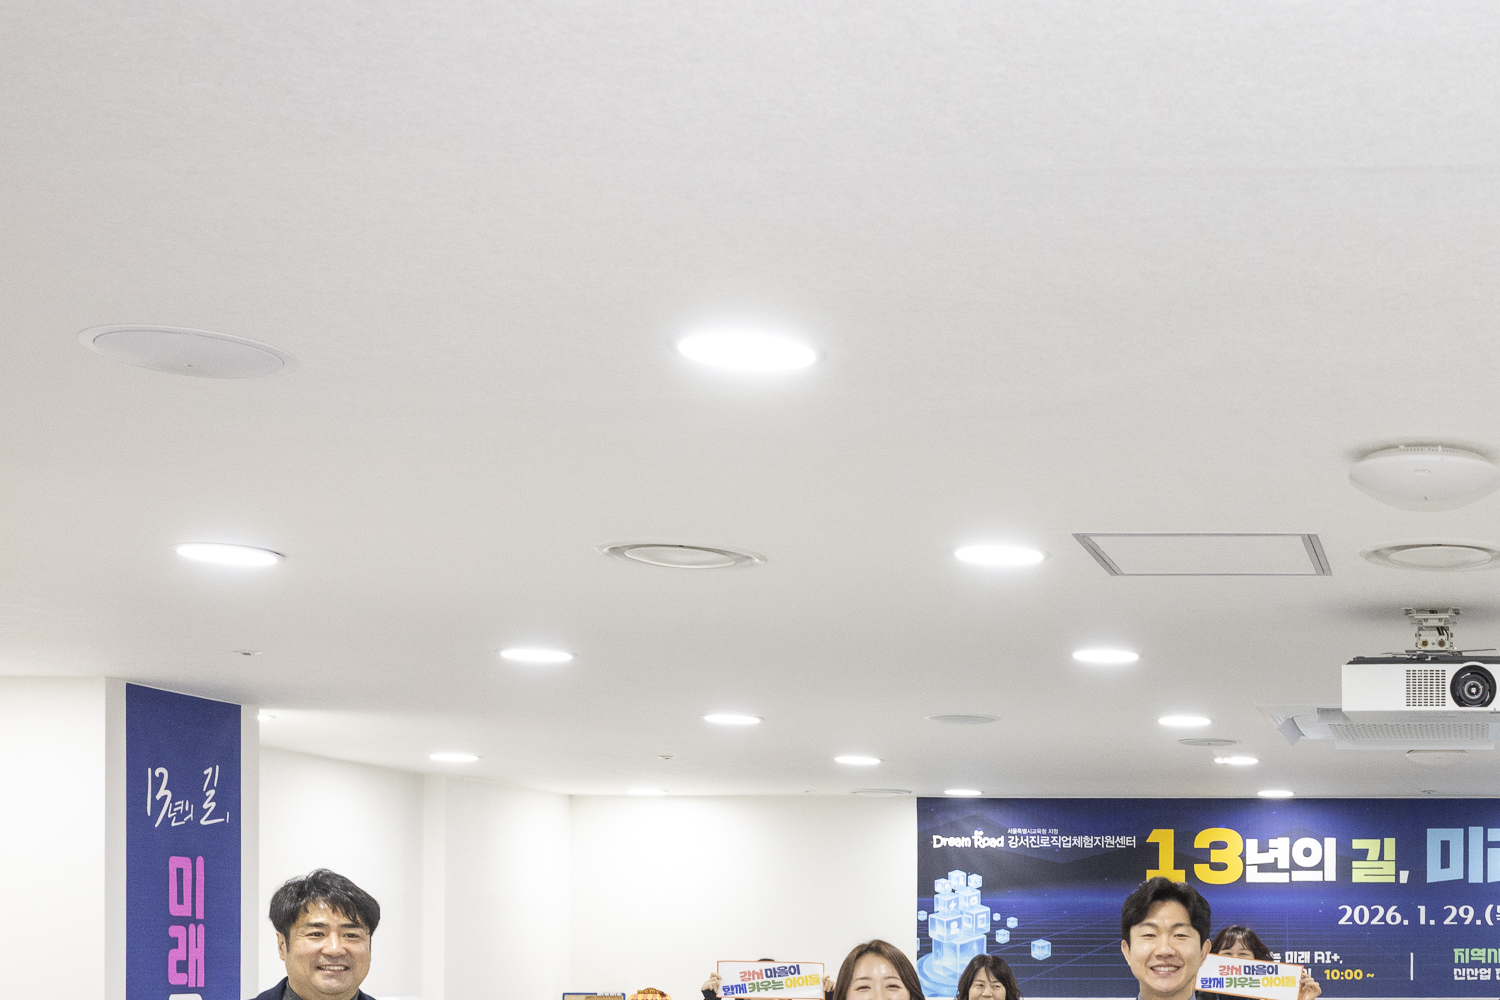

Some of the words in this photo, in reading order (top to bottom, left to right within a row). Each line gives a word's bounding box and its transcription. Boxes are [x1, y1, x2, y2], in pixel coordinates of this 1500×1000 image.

[932, 834, 971, 849] Dream
[972, 831, 1004, 849] Road
[1007, 835, 1136, 849] 강서진로직업체험지원센터
[1145, 827, 1337, 885] 13년의
[1351, 838, 1410, 885] 길,
[1338, 904, 1409, 925] 2026.
[1417, 905, 1435, 925] 1.
[1285, 951, 1310, 964] 미래
[739, 968, 764, 982] 강서
[764, 964, 800, 979] 마을이
[1218, 964, 1242, 976] 강서
[1243, 964, 1279, 976] 마을이
[1324, 969, 1363, 980] 10:00
[1453, 968, 1491, 980] 신산업
[722, 984, 747, 996] 함께
[748, 979, 784, 993] 키우는
[784, 974, 820, 988] 아이들
[1200, 977, 1224, 989] 함께
[1225, 976, 1260, 988] 키우는
[1261, 976, 1297, 987] 아이들
